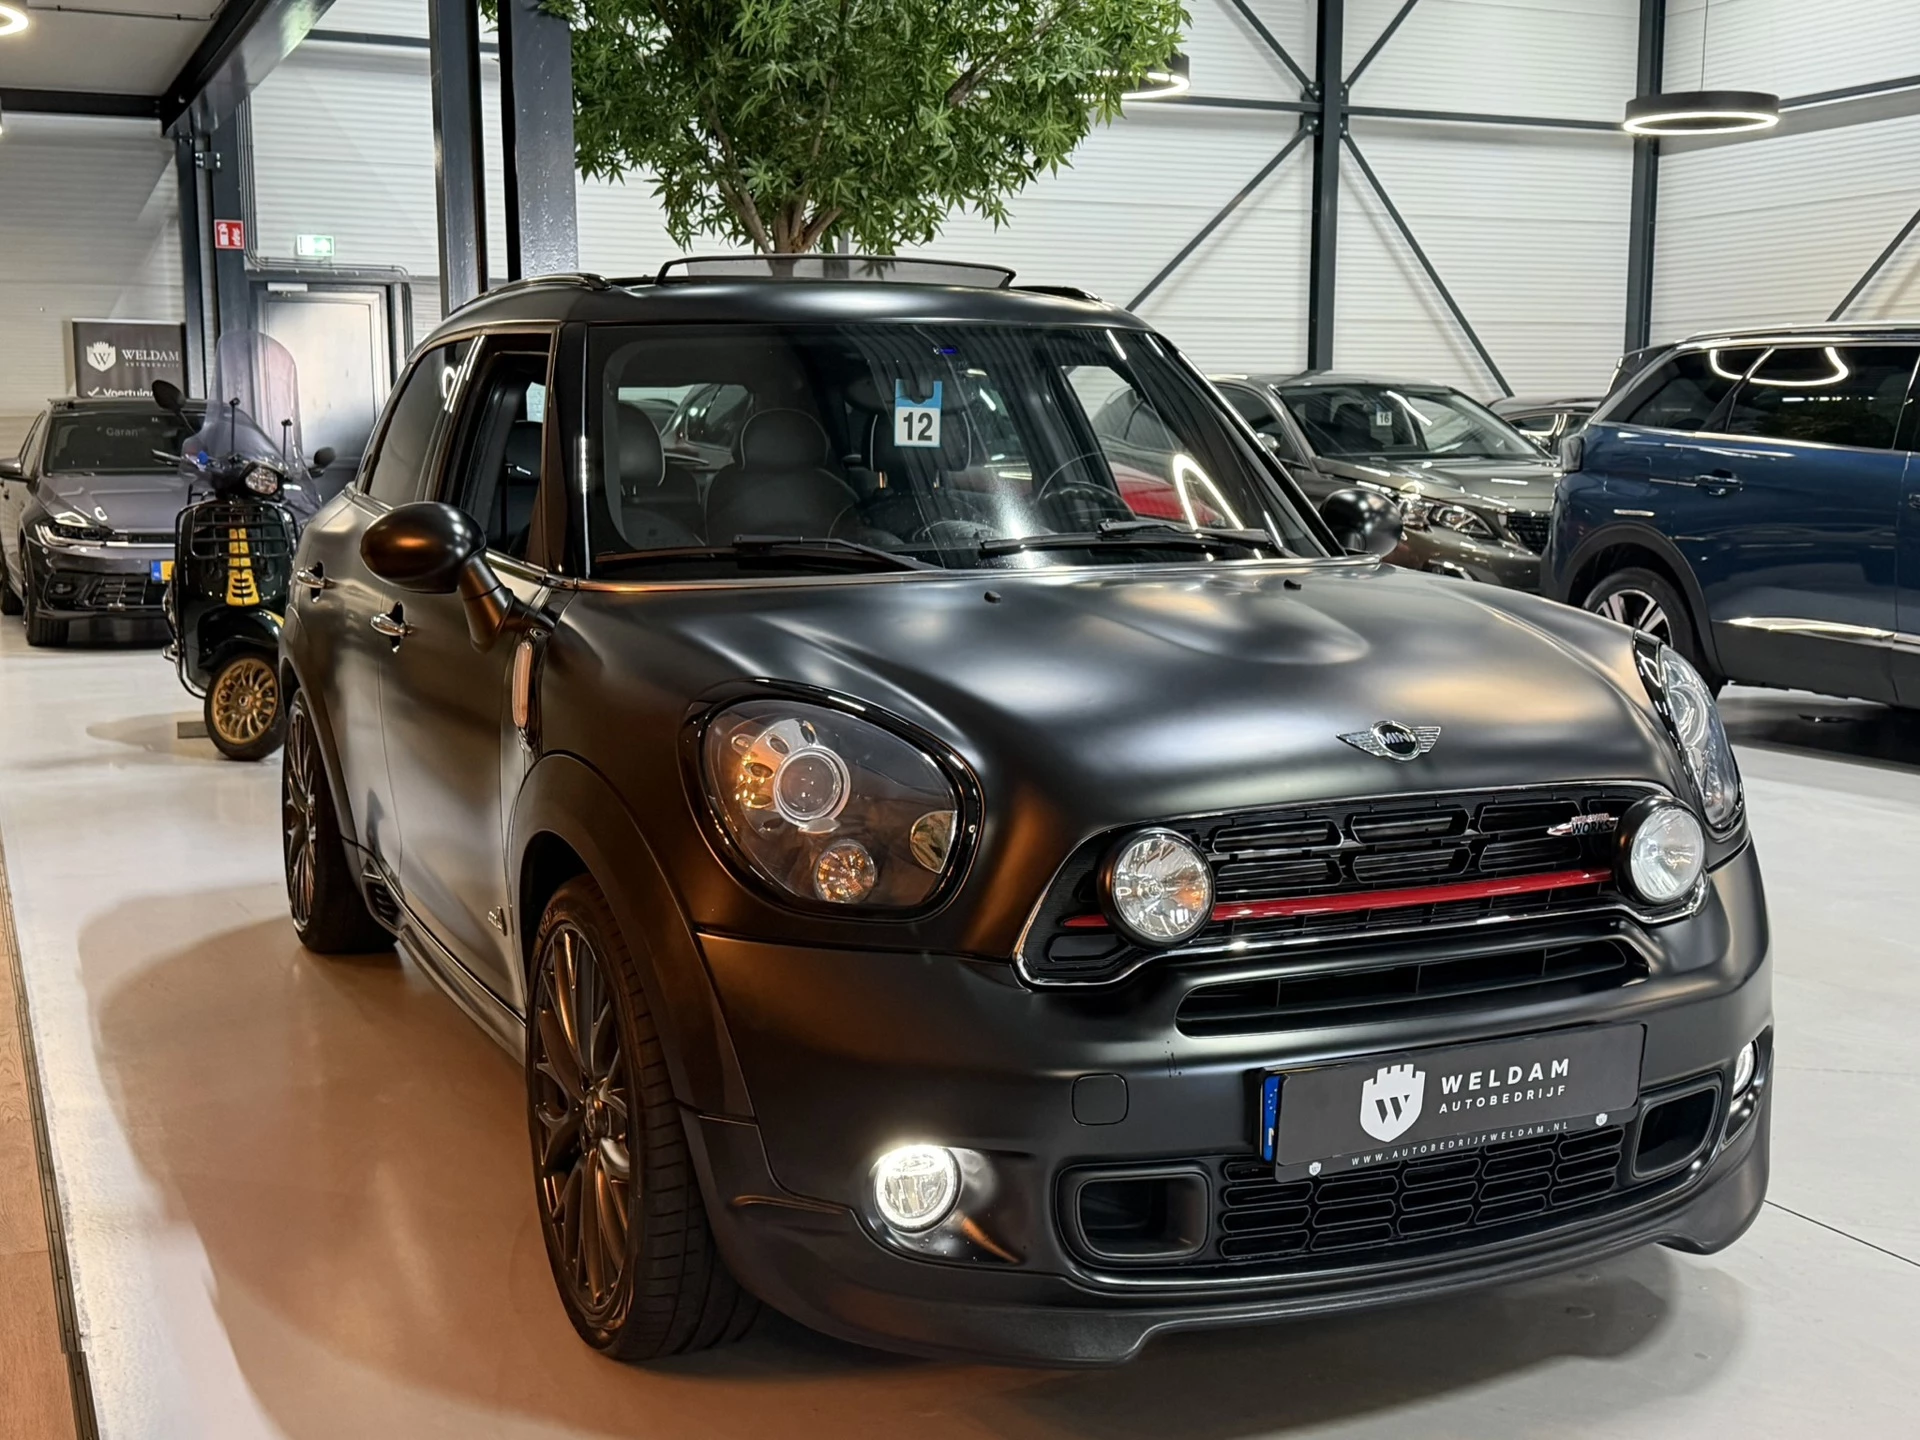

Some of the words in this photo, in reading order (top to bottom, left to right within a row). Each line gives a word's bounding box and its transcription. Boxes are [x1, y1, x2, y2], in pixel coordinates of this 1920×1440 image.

[121, 349, 179, 362] WELDAM
[903, 411, 933, 441] 12
[1380, 413, 1390, 424] 16
[1379, 731, 1416, 745] MINI
[1572, 820, 1614, 834] WORKS
[1441, 1058, 1569, 1095] WELDAM
[1439, 1085, 1566, 1114] AUTOBEDRIJF
[1351, 1121, 1569, 1166] WWW.AUTOBEDRIJFWELDAM.NL
